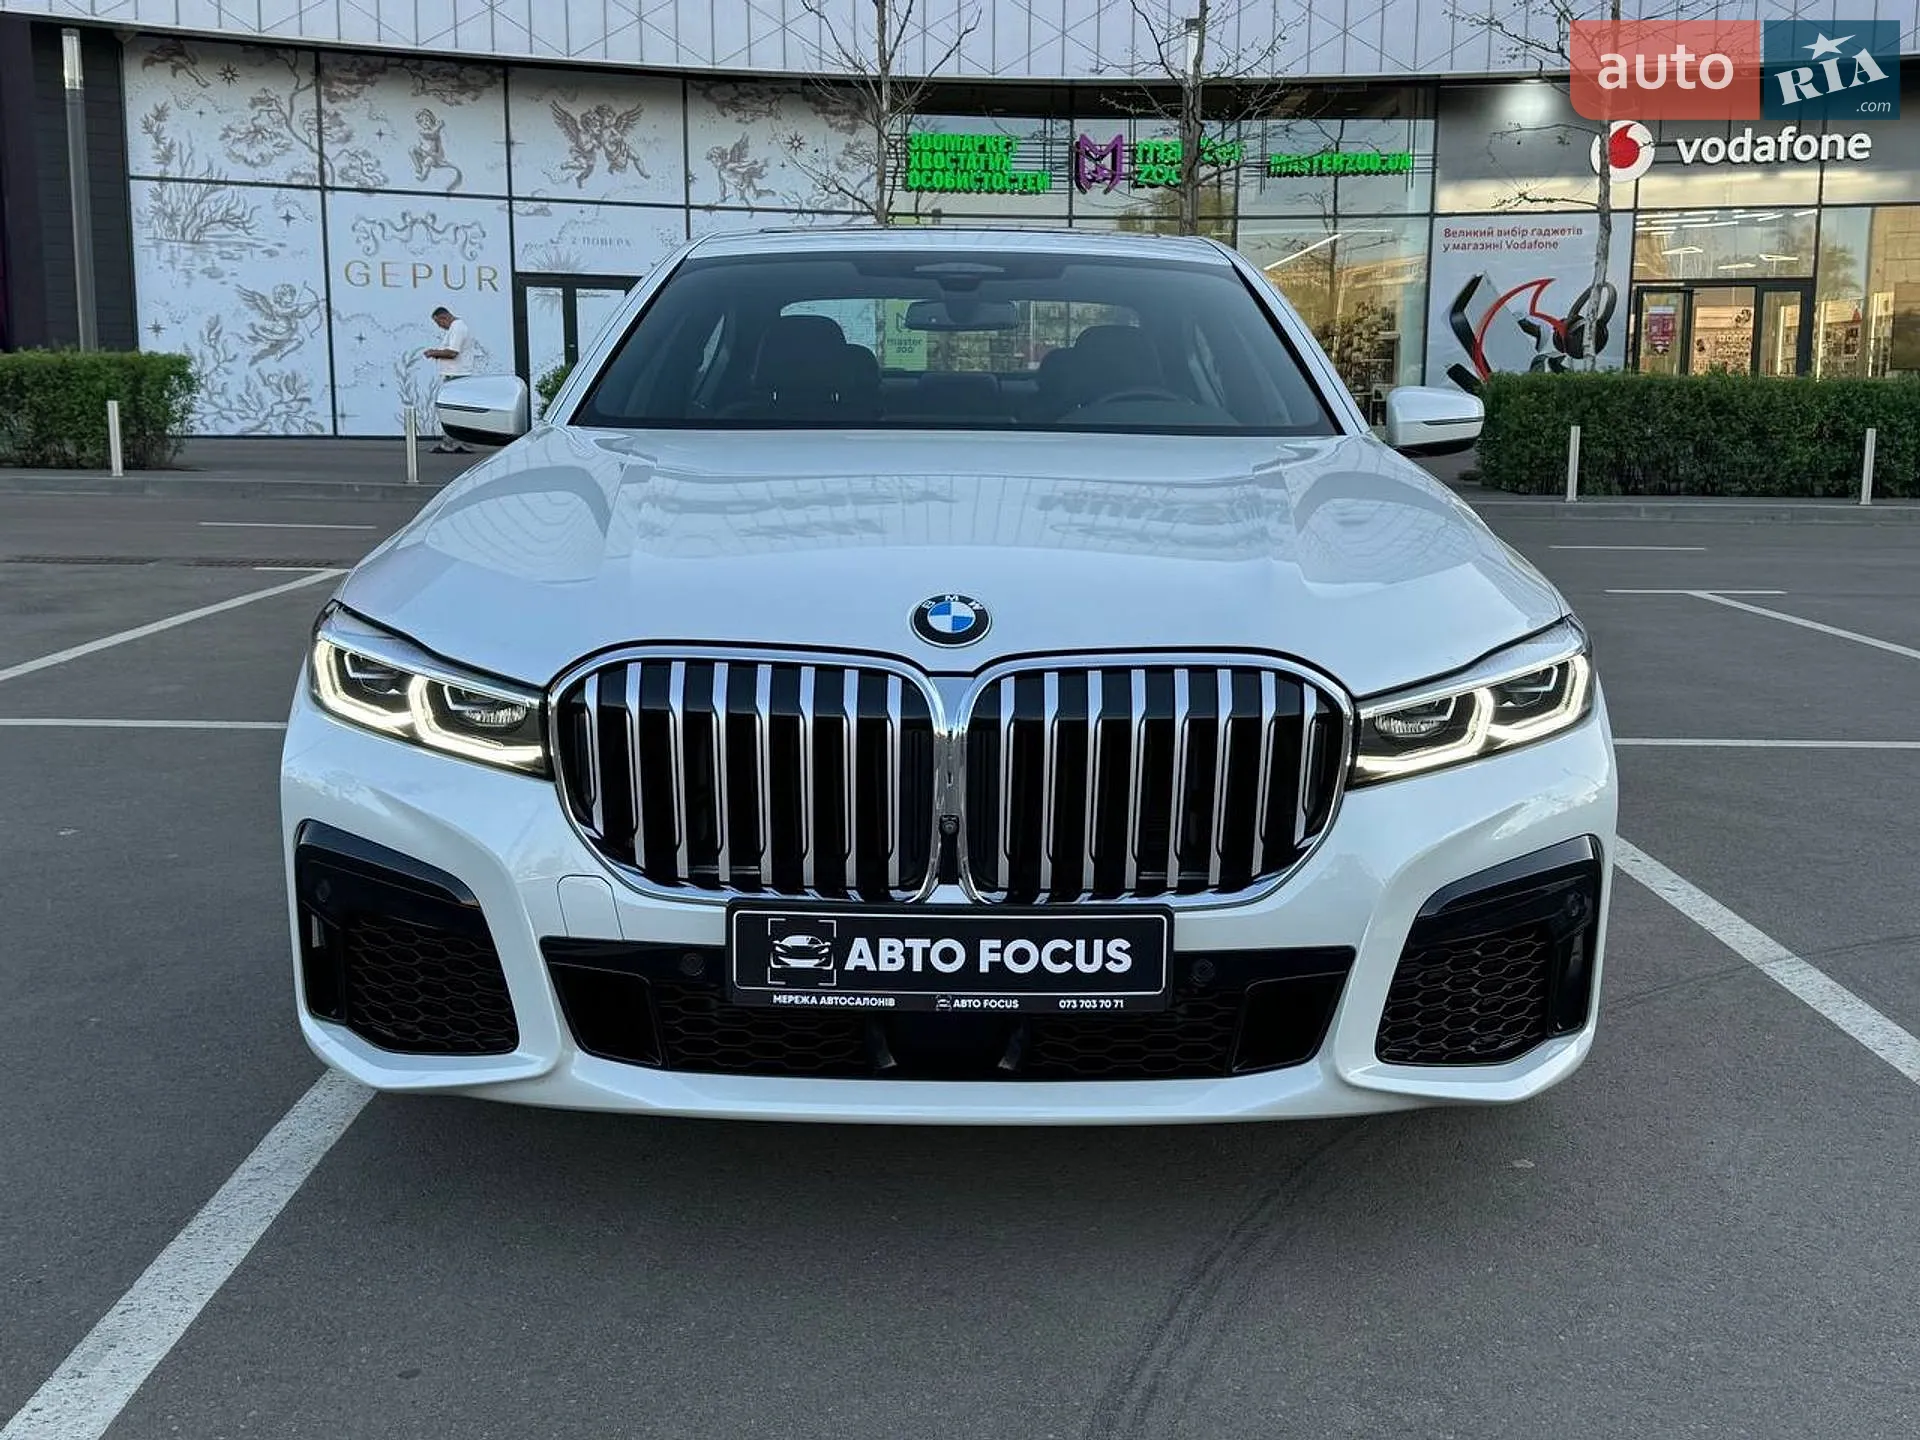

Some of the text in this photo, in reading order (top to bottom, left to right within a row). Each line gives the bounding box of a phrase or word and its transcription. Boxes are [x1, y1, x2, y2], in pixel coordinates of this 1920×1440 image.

[1676, 127, 1872, 165] vodafone
[1444, 227, 1494, 239] Великий
[1505, 239, 1560, 250] Vodafone
[344, 260, 499, 292] GEPUR
[844, 937, 1133, 974] АВТО FOCUS
[953, 999, 1020, 1010] АВТО FOCUS
[1058, 999, 1124, 1009] 073 703 70 71
